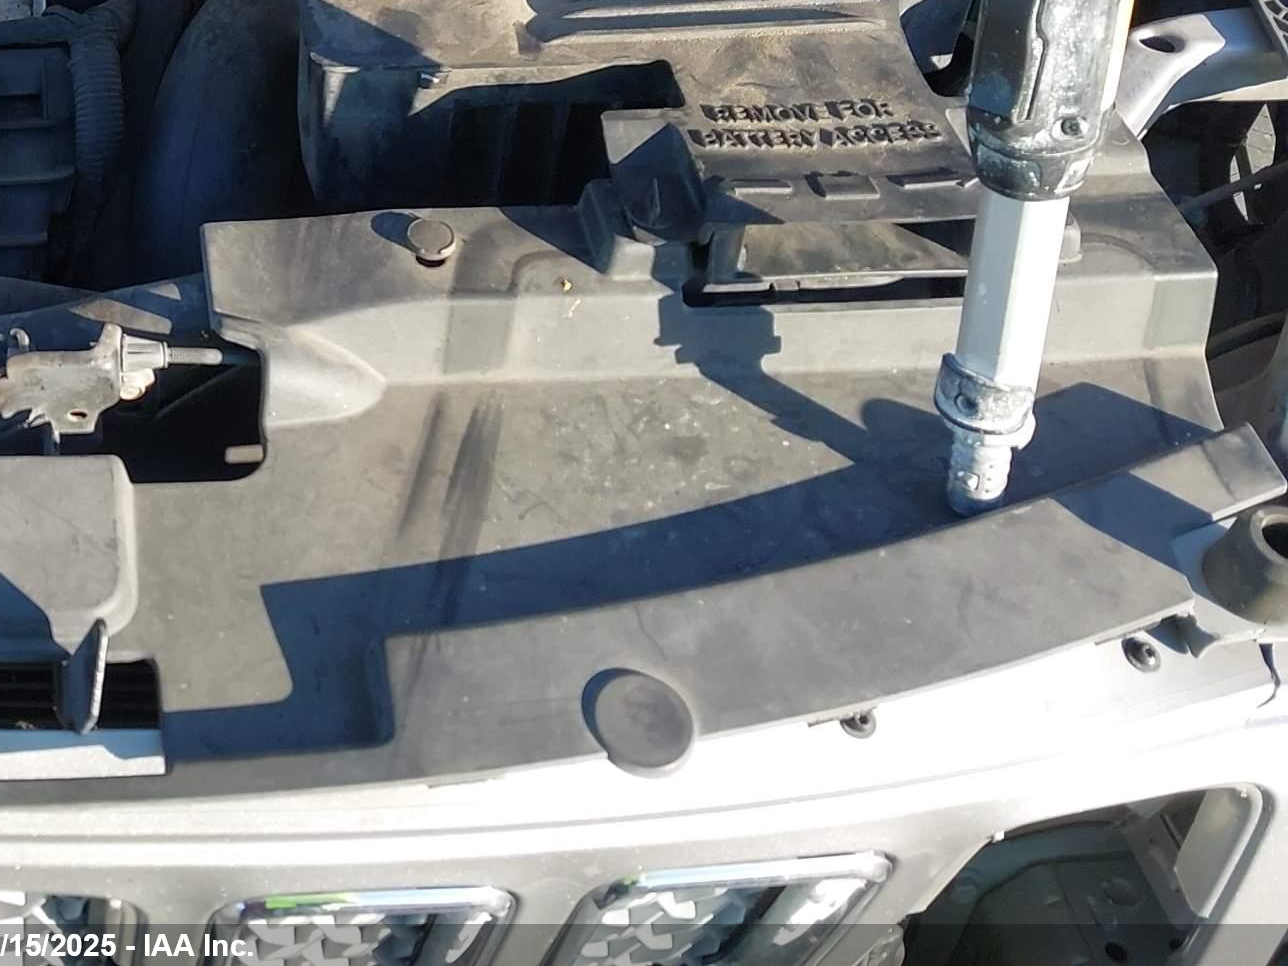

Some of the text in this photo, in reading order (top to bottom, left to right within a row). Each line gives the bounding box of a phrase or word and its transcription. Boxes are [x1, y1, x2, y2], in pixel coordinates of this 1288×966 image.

[702, 98, 894, 124] REMOVE FOR
[689, 127, 818, 148] BATTERY
